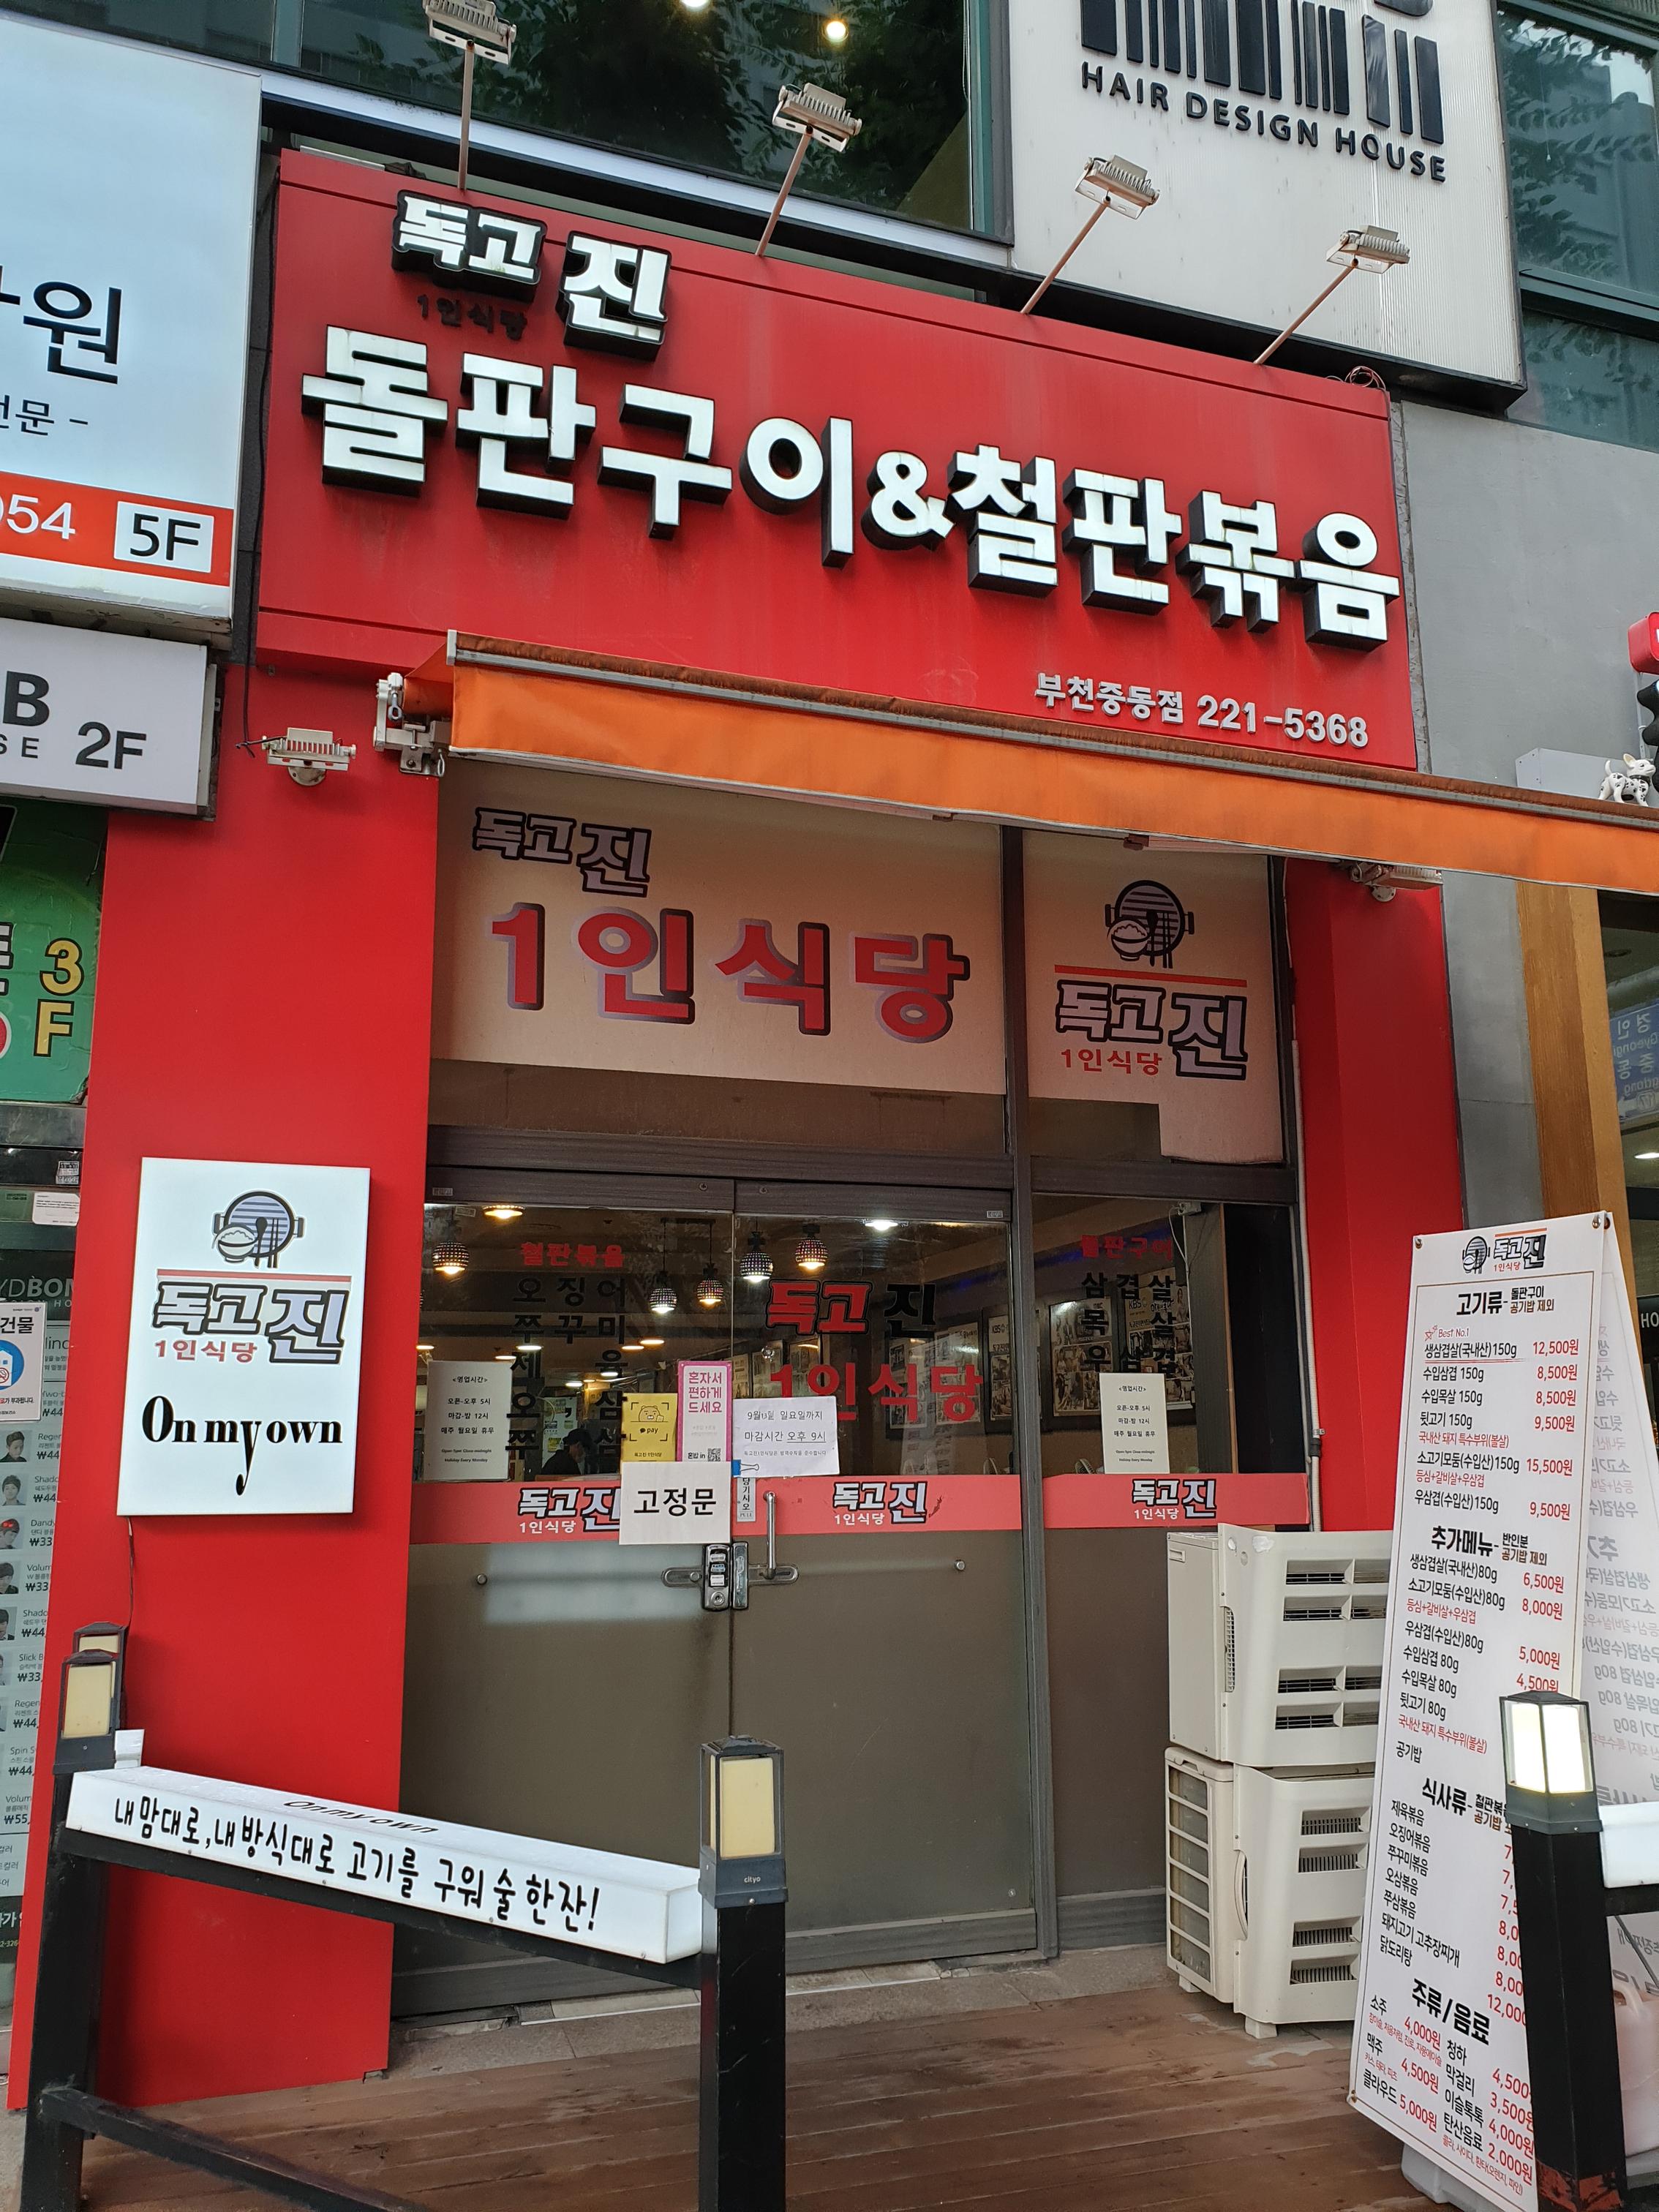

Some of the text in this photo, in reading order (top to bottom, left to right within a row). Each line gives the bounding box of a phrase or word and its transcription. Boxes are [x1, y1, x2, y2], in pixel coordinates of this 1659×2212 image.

[1081, 61, 1446, 183] HAIR DESIGN HOUSE
[392, 189, 672, 358] 독고진
[416, 294, 529, 342] 1인식당
[301, 324, 1400, 651] 돌판구이&철판볶음
[130, 514, 200, 563] 5F
[1035, 672, 1369, 749] 부천중동점 221-5368
[75, 721, 146, 772] 2F
[472, 806, 653, 898] 독고진
[486, 903, 971, 1045] 1인식당
[1055, 979, 1248, 1080] 독고진
[1061, 1048, 1163, 1076] 1인식당
[1494, 1235, 1547, 1270] 독고진
[1494, 1261, 1521, 1272] 1인식당
[513, 1276, 625, 1308] 오징어
[1081, 1272, 1176, 1300] 삼겹살
[1511, 1286, 1544, 1301] 돌판구이
[1510, 1298, 1554, 1314] 공기밥 제외
[151, 1281, 350, 1364] 독고진
[512, 1314, 625, 1345] 쭈꾸미
[154, 1339, 257, 1364] 1인식당
[1532, 1339, 1579, 1357] 12,500원
[688, 1371, 723, 1385] 혼자서
[1423, 1364, 1577, 1383] 수입삼겹 150g 8,500원
[688, 1386, 723, 1400] 편하게
[770, 1362, 984, 1423] 1인식당
[1421, 1389, 1576, 1407] 수입목살 150g 8,500원
[688, 1401, 723, 1414] 드세요
[780, 1410, 823, 1421] 일요일까지
[1420, 1412, 1575, 1432] 뒷고기 150g 9,500원
[142, 1396, 343, 1496] On my own
[745, 1431, 826, 1442] 마감시간 오후 9시
[1527, 1458, 1573, 1476] 15,500원
[518, 1486, 620, 1532] 독고진
[633, 1487, 718, 1516] 고정문
[832, 1481, 928, 1524] 독고진
[1132, 1478, 1216, 1519] 독고진
[1530, 1502, 1570, 1520] 9,500원
[519, 1521, 576, 1533] 1인식당
[835, 1513, 884, 1526] 1인식당
[1134, 1508, 1179, 1520] 1인식당
[1502, 1532, 1529, 1549] 반인분
[1501, 1547, 1547, 1566] 공기밥 제외
[1523, 1572, 1564, 1594] 6,500원
[1522, 1598, 1562, 1620] 8,000원
[1403, 1645, 1459, 1673] 수입삼겹 80g
[1519, 1646, 1560, 1670] 5,000원
[1402, 1669, 1437, 1693] 수입목살
[1439, 1680, 1457, 1698] 80g
[1399, 1692, 1446, 1721] 뒷고기 80g
[1396, 1740, 1423, 1764] 공기밥
[1391, 1799, 1425, 1827] 제육볶음
[1474, 1809, 1502, 1832] 공기밥
[1475, 1794, 1507, 1818] 철판볶
[1389, 1823, 1431, 1854] 오징어볶음
[346, 1841, 420, 1899] 고기를
[1388, 1844, 1429, 1877] 쭈꾸미볶음
[1385, 1867, 1419, 1897] 오삼볶음
[1383, 1889, 1417, 1919] 쭈삼볶음
[1380, 1934, 1412, 1967] 닭도리탕
[1381, 1912, 1460, 1968] 돼지고기 고추장찌개
[1369, 1995, 1441, 2052] 소주 4,000원
[1412, 1978, 1490, 2046] 주류/음료
[1366, 2033, 1439, 2094] 맥주 4,500원
[1447, 2039, 1467, 2066] 청하
[1446, 2064, 1475, 2097] 막걸리
[1363, 2069, 1437, 2133] 클라우드 5,000원
[1445, 2089, 1483, 2128] 이슬톡톡
[1444, 2113, 1483, 2152] 탄산음료
